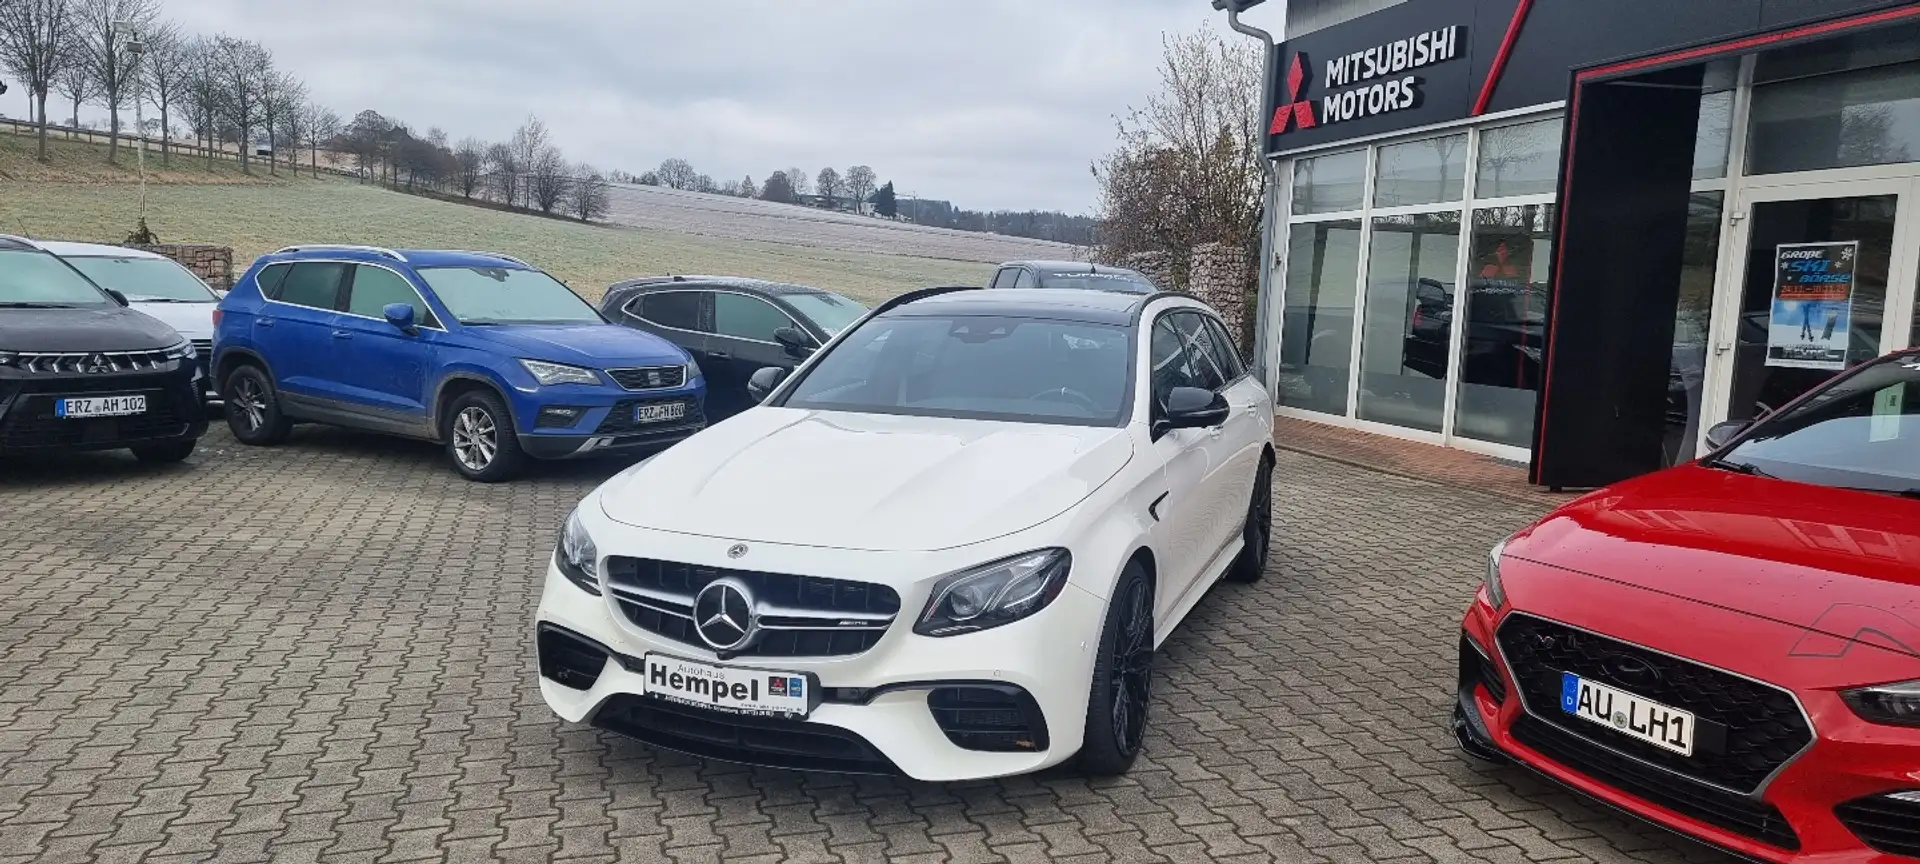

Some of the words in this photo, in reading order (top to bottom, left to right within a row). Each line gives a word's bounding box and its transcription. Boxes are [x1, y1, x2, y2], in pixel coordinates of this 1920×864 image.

[1325, 25, 1457, 88] MITSUBISHI
[1322, 75, 1415, 124] MOTORS
[1788, 259, 1831, 272] SKI
[66, 400, 92, 414] ERZ
[103, 399, 119, 412] AH
[122, 397, 145, 411] 102
[638, 407, 655, 420] ERZ
[650, 662, 759, 703] Hempel
[677, 663, 725, 680] Autohaus
[1577, 684, 1613, 722] AU
